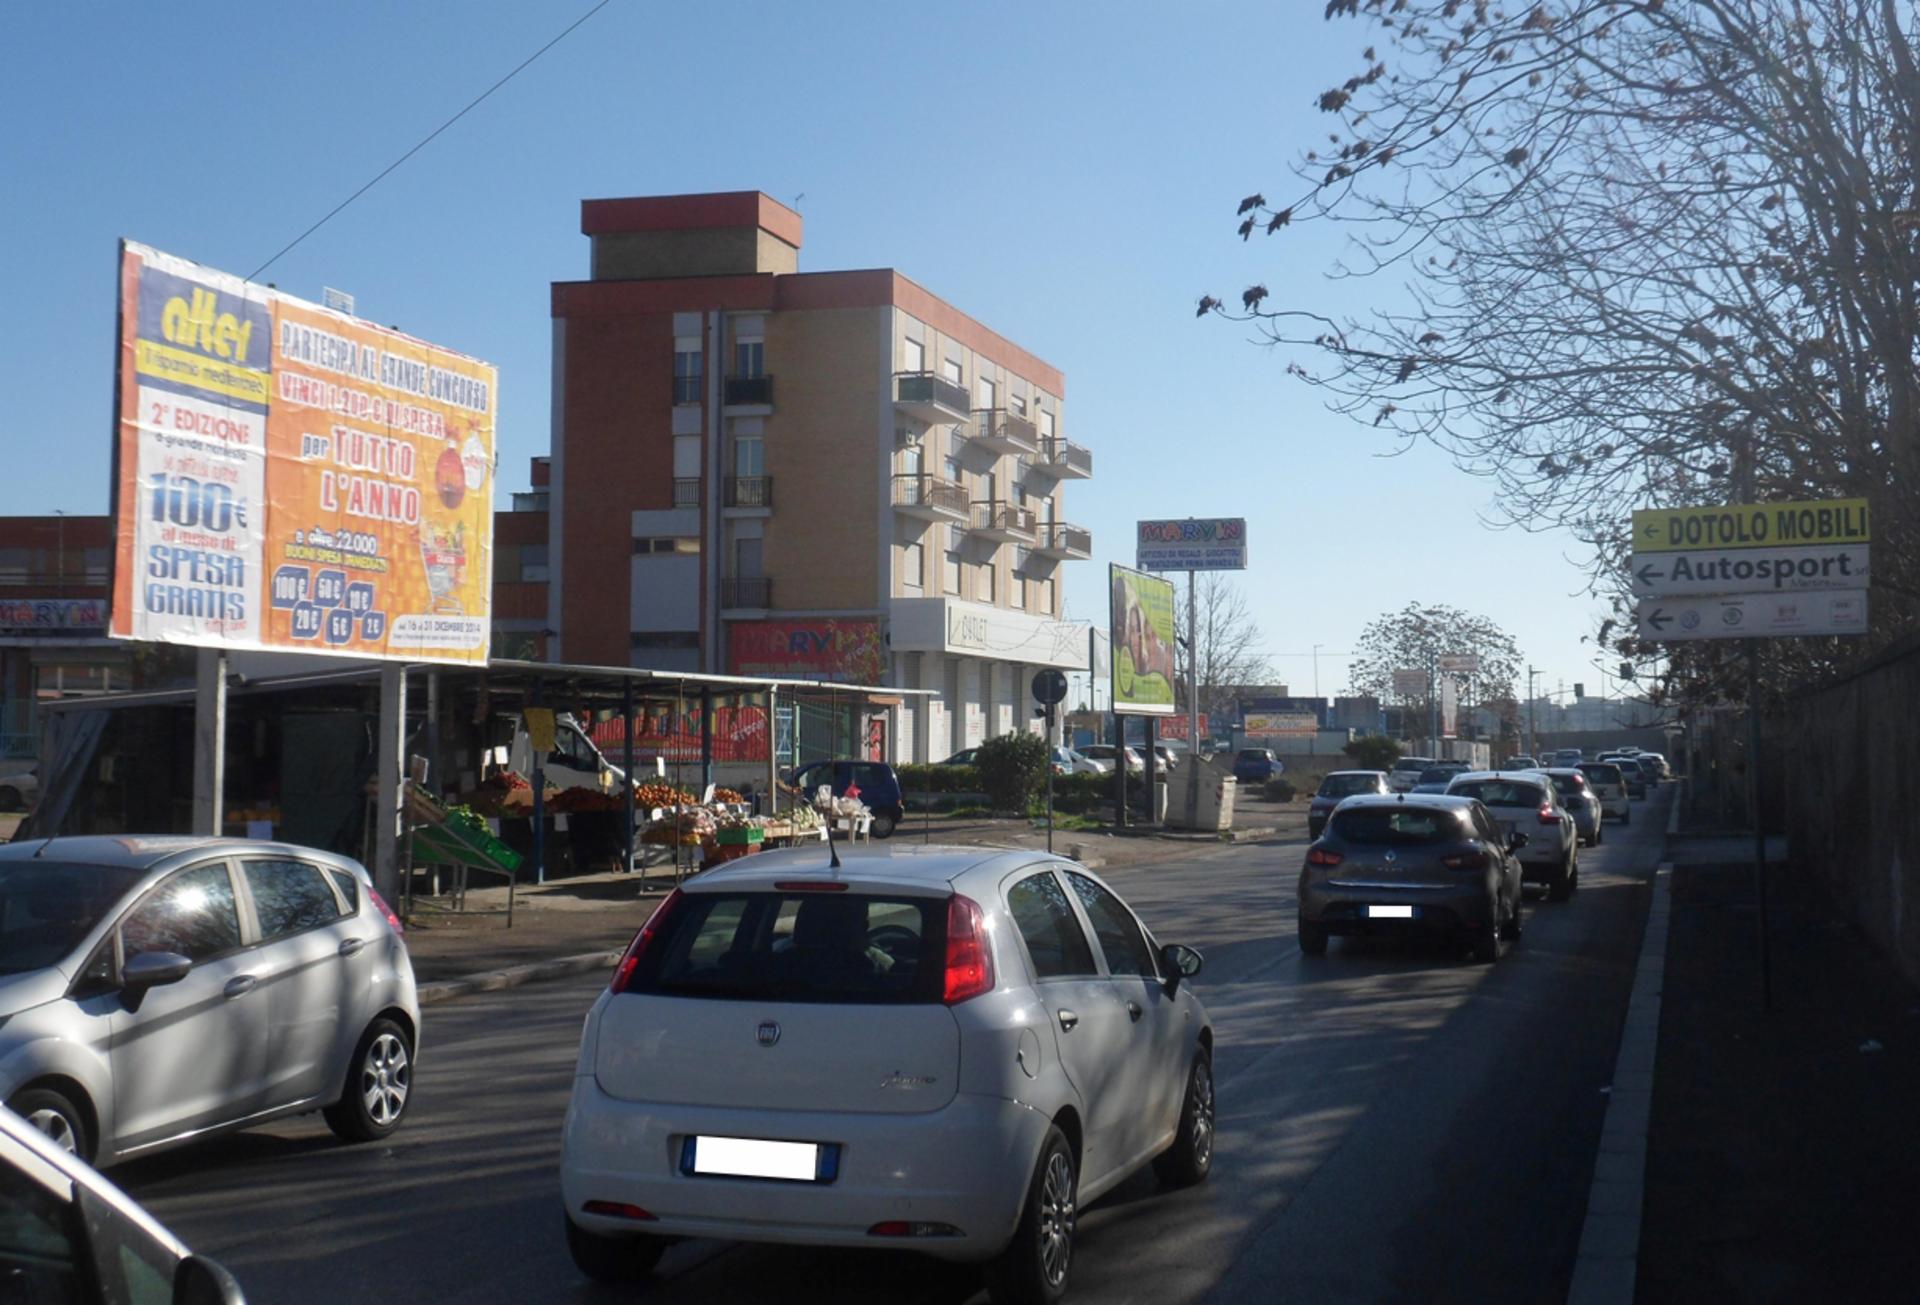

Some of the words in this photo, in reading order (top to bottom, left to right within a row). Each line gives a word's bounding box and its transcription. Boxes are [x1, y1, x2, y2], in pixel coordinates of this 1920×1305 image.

[281, 323, 357, 376] PARTECIPA
[361, 346, 377, 382] AL
[380, 353, 425, 395] GRANDE
[429, 367, 488, 412] CONCORSO
[175, 407, 250, 443] EDIZIONE
[281, 372, 326, 408] VINCI
[402, 406, 445, 439] SPESA
[303, 433, 327, 457] per
[334, 427, 415, 479] TUTTO
[321, 471, 419, 524] L'ANNO
[1141, 521, 1241, 542] MARVIN
[1669, 511, 1768, 546] DOTOLO
[1777, 506, 1866, 540] MOBILI
[148, 544, 244, 588] SPESA
[1670, 552, 1852, 588] Autosport
[146, 583, 245, 620] GRATIS
